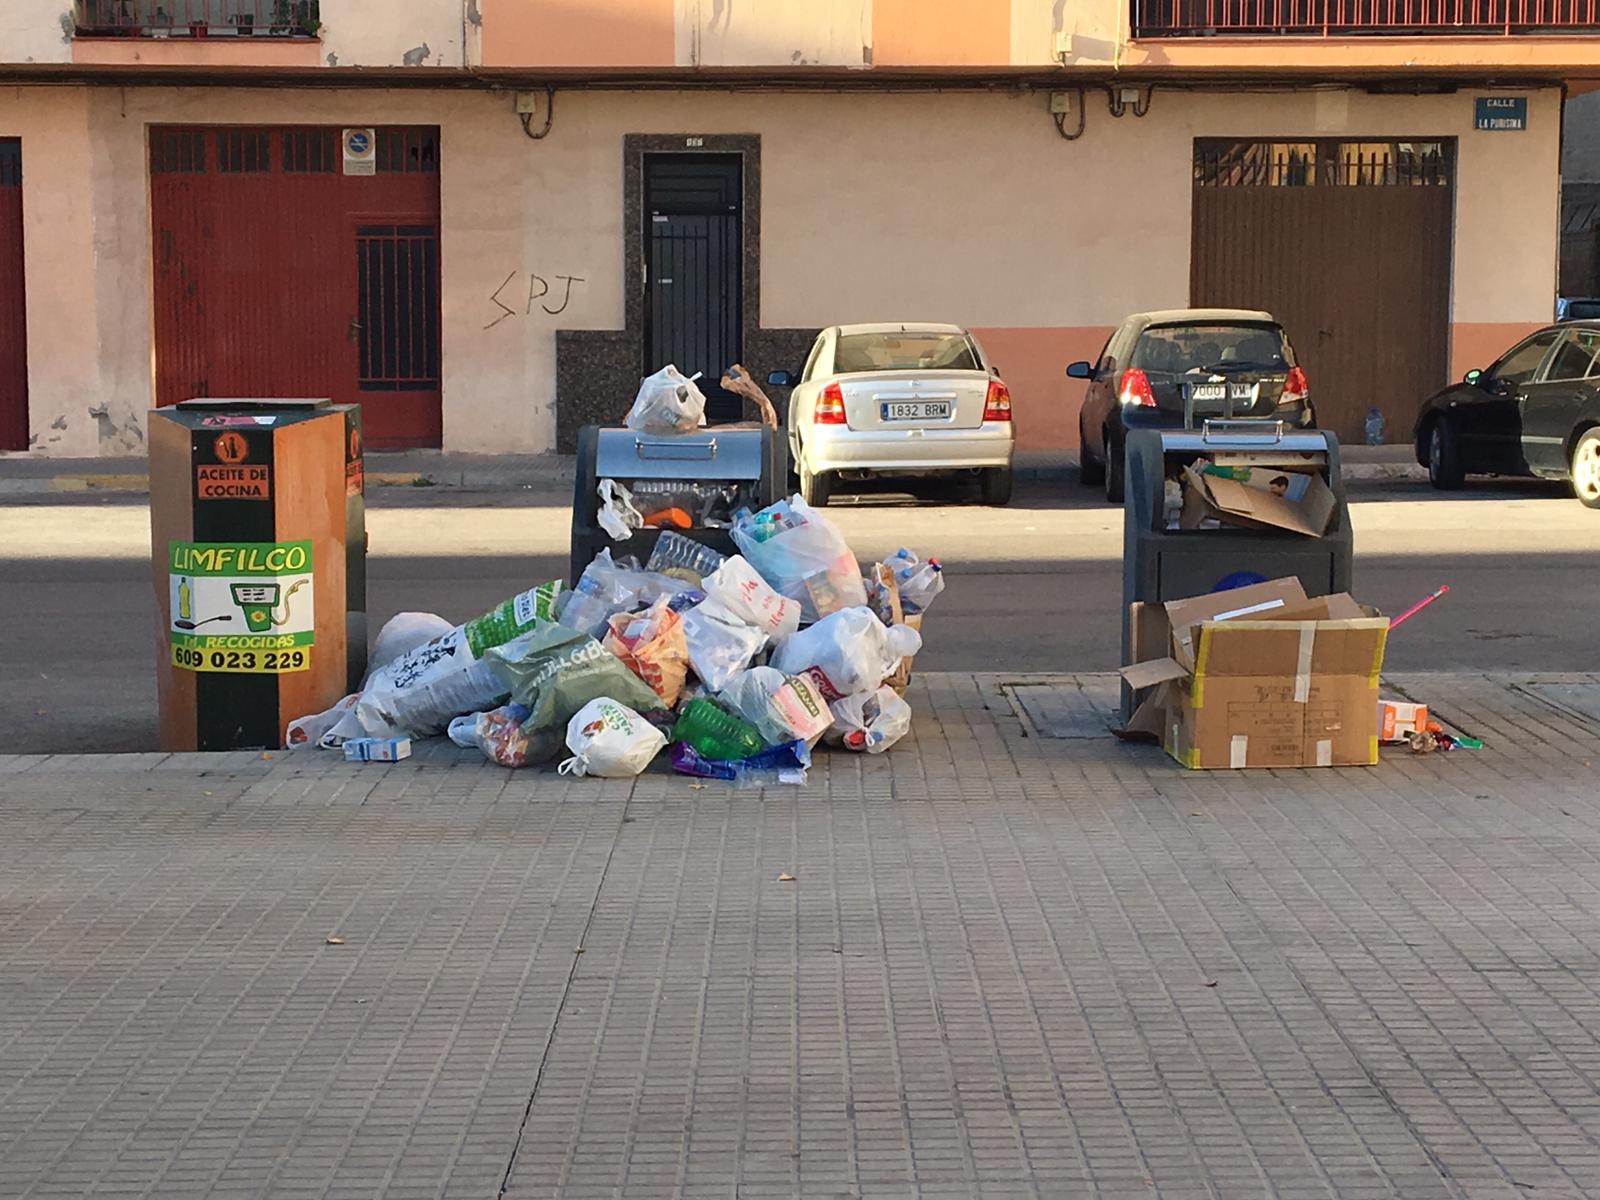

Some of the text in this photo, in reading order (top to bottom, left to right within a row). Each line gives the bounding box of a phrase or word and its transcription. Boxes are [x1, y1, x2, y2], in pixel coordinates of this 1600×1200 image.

[1486, 99, 1515, 107] CALLE
[891, 404, 919, 417] 1832
[199, 468, 267, 481] ACEITE DE
[205, 485, 261, 496] COCINA
[174, 546, 306, 571] LIMFILCO
[205, 634, 295, 649] RECOGIDAS
[175, 647, 304, 669] 609 023 229
